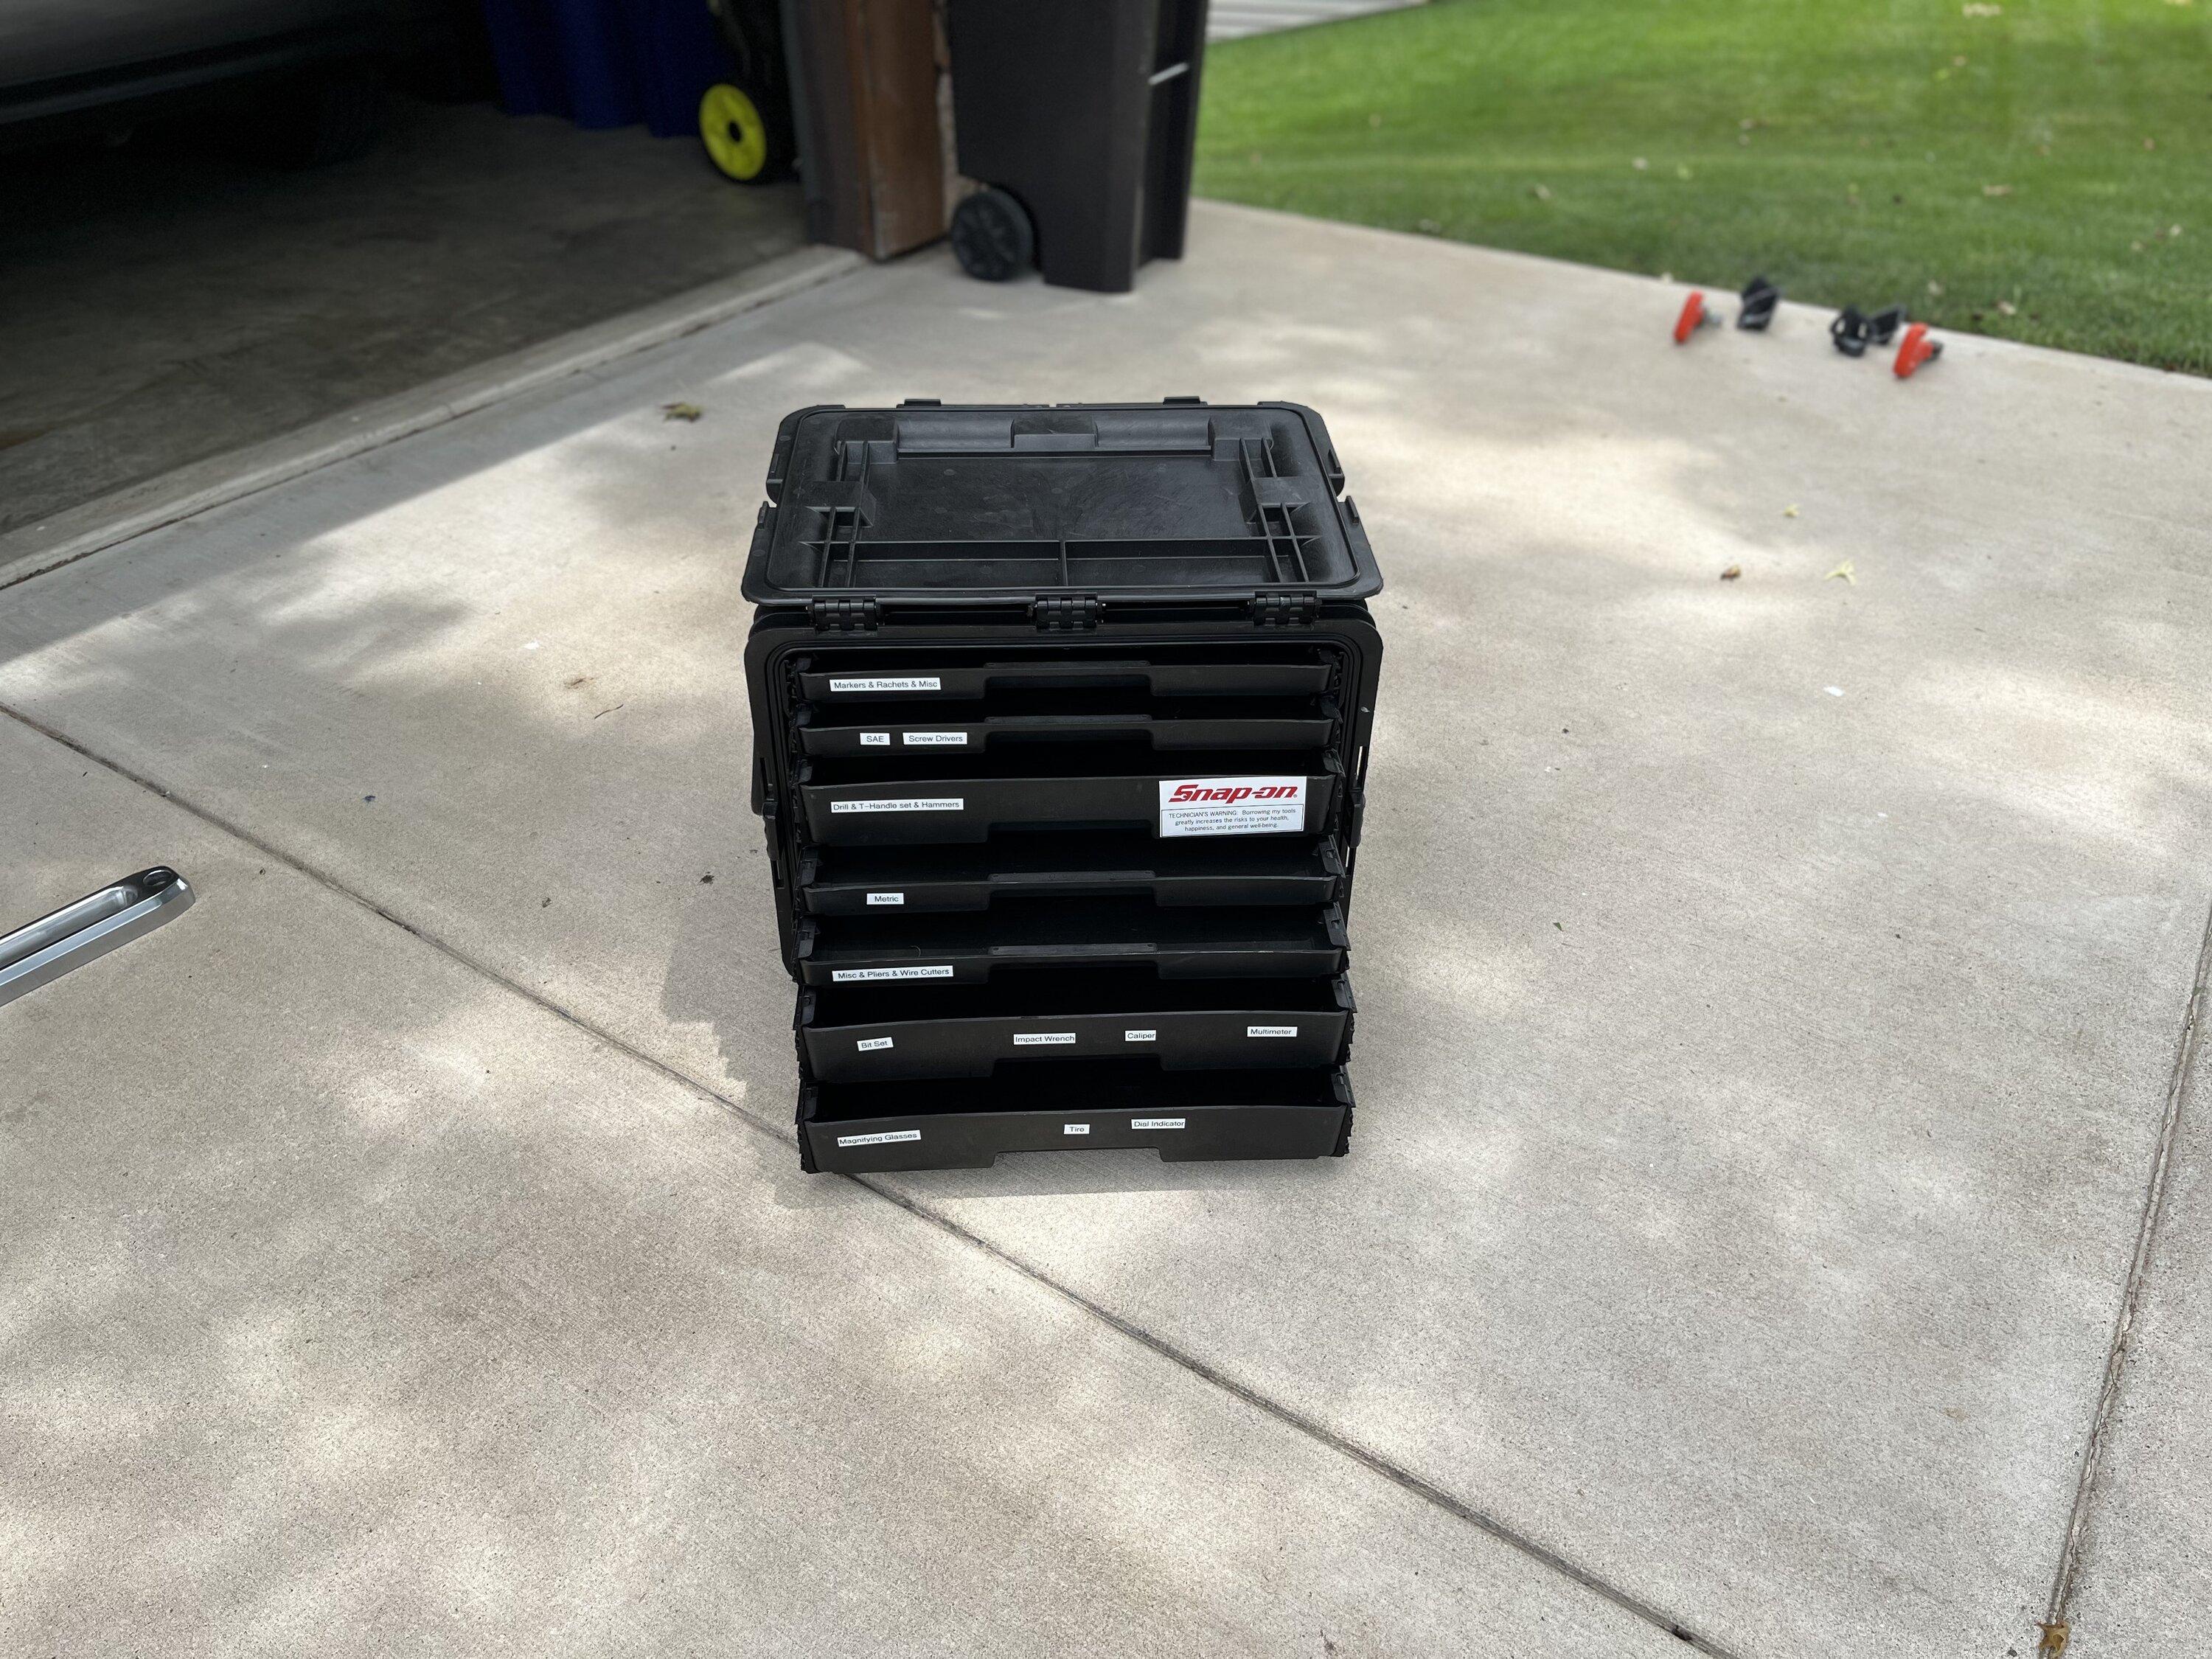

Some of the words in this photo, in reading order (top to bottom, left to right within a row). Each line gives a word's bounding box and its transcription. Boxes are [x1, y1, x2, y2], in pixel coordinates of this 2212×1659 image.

[1168, 785, 1298, 804] Snap-on
[1015, 1035, 1043, 1043] Impact
[1127, 1032, 1155, 1040] Caliper
[839, 1135, 883, 1145] Magnifying
[885, 1133, 917, 1141] Glasses
